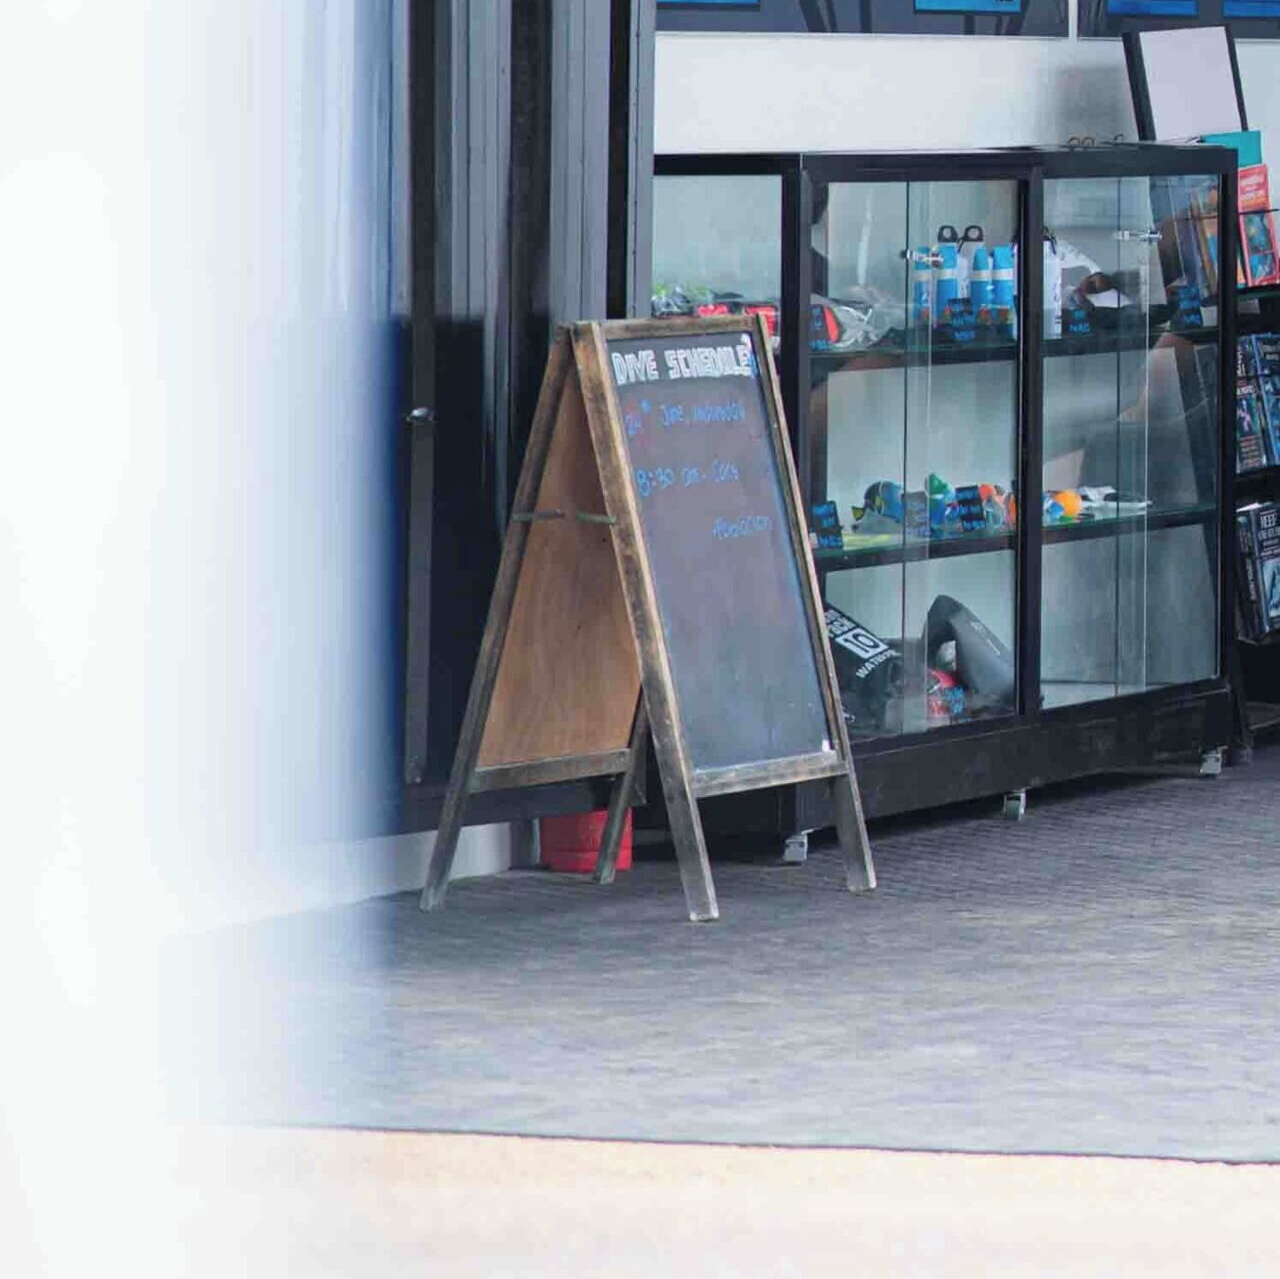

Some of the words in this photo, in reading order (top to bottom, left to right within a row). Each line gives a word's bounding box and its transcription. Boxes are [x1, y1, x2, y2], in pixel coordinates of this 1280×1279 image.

[611, 350, 659, 386] DIVE
[663, 344, 752, 380] SCHEDULE
[636, 466, 674, 496] 8:30
[842, 633, 881, 654] 10
